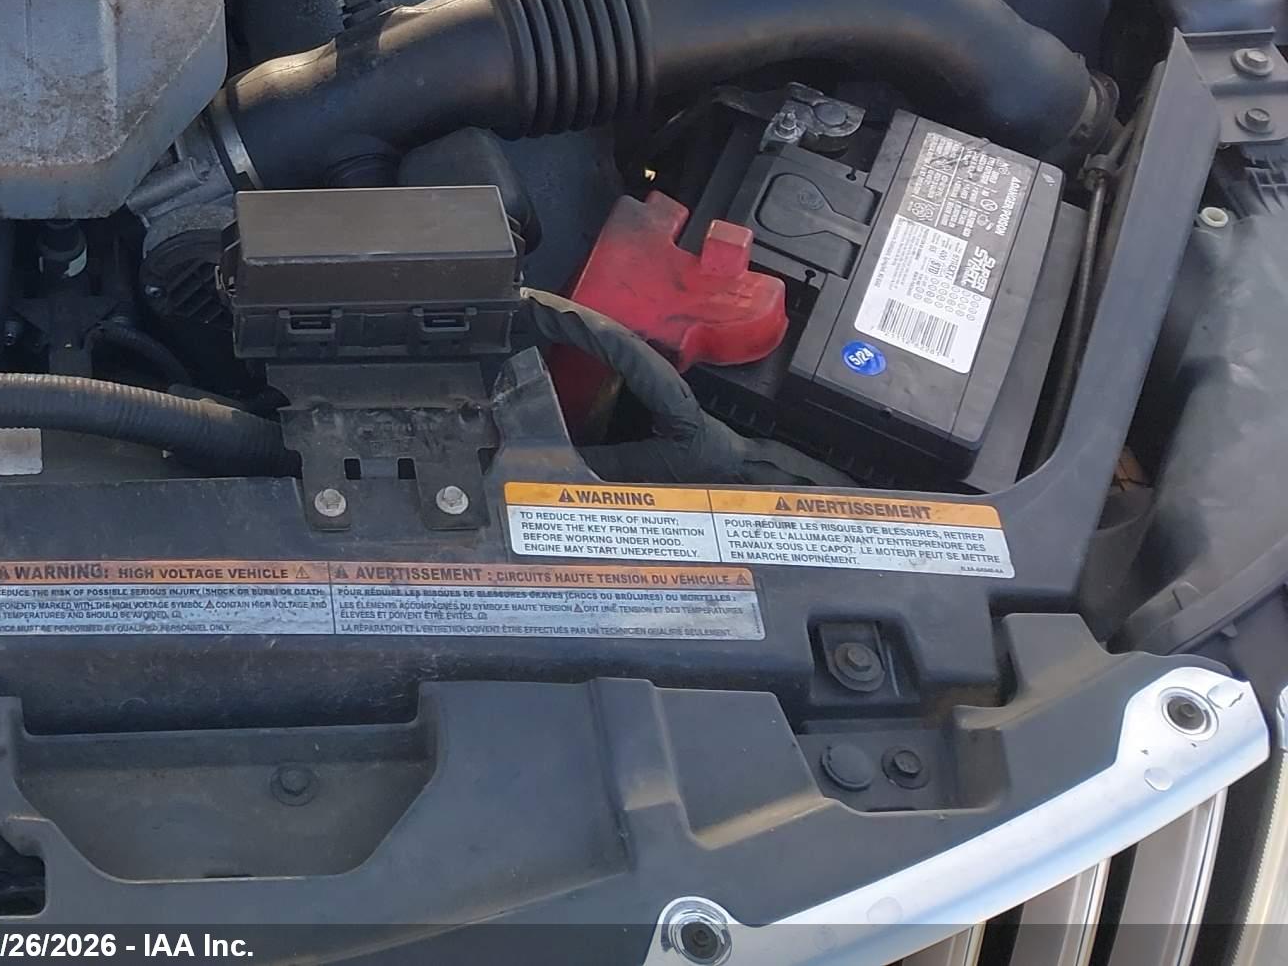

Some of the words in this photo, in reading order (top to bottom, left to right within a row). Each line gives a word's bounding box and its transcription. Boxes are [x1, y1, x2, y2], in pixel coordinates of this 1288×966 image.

[974, 256, 996, 292] SUPER
[848, 347, 874, 365] 5/24
[575, 490, 655, 506] WARNING
[794, 499, 932, 519] AVERTISSEMENT
[520, 511, 533, 519] TO
[535, 511, 576, 521] REDUCE
[579, 513, 597, 522] THE
[600, 514, 623, 523] RISK
[625, 515, 638, 524] OF
[521, 522, 563, 531] REMOVE
[565, 523, 584, 532] THE
[587, 524, 607, 533] KEY
[609, 525, 637, 534] FROM
[640, 526, 659, 535] THE
[662, 527, 705, 536] IGNITION
[799, 522, 818, 532] LES
[820, 523, 863, 534] RISQUES
[865, 526, 880, 535] DE
[881, 527, 942, 538] BLESSURES,
[943, 530, 984, 541] RETIRER
[522, 532, 562, 542] BEFORE
[565, 534, 612, 543] WORKING
[615, 536, 649, 545] UNDER
[652, 537, 684, 546] HOOD.
[726, 529, 740, 538] LA
[741, 528, 762, 539] CLÉ
[762, 531, 777, 540] DE
[779, 532, 841, 543] L'ALLUMAGE
[843, 535, 875, 545] AVANT
[875, 537, 965, 550] D'ENTREPRENDRE
[966, 542, 986, 551] DES
[524, 543, 561, 552] ENGINE
[564, 544, 584, 553] MAY
[587, 545, 617, 554] START
[620, 547, 699, 557] UNEXPECTEDLY.
[728, 540, 774, 551] TRAVAUX
[776, 542, 804, 553] SOUS
[805, 544, 819, 553] LE
[821, 545, 857, 555] CAPOT.
[860, 547, 874, 556] LE
[875, 547, 917, 559] MOTEUR
[918, 550, 944, 560] PEUT
[945, 551, 959, 561] SE
[960, 552, 1000, 563] METTRE
[730, 550, 744, 559] EN
[746, 551, 789, 561] MARCHE
[15, 565, 108, 579] WARNING:
[118, 568, 154, 578] HIGH
[158, 568, 223, 578] VOLTAGE
[227, 568, 288, 578] VEHICLE
[355, 566, 484, 581] AVERTISSEMENT
[496, 572, 552, 582] CIRCUITS
[554, 573, 594, 583] HAUTE
[596, 573, 648, 584] TENSION
[652, 574, 668, 584] DU
[31, 588, 48, 596] THE
[51, 588, 70, 596] RISK
[86, 588, 127, 596] POSSIBLE
[130, 588, 166, 596] SERIOUS
[74, 601, 92, 609] WITH
[94, 601, 110, 609] THE
[112, 601, 131, 609] HIGH
[134, 601, 168, 609] VOLTAGE
[3, 611, 65, 619] TEMPERATURES
[68, 611, 83, 619] AND
[86, 611, 117, 619] SHOULD
